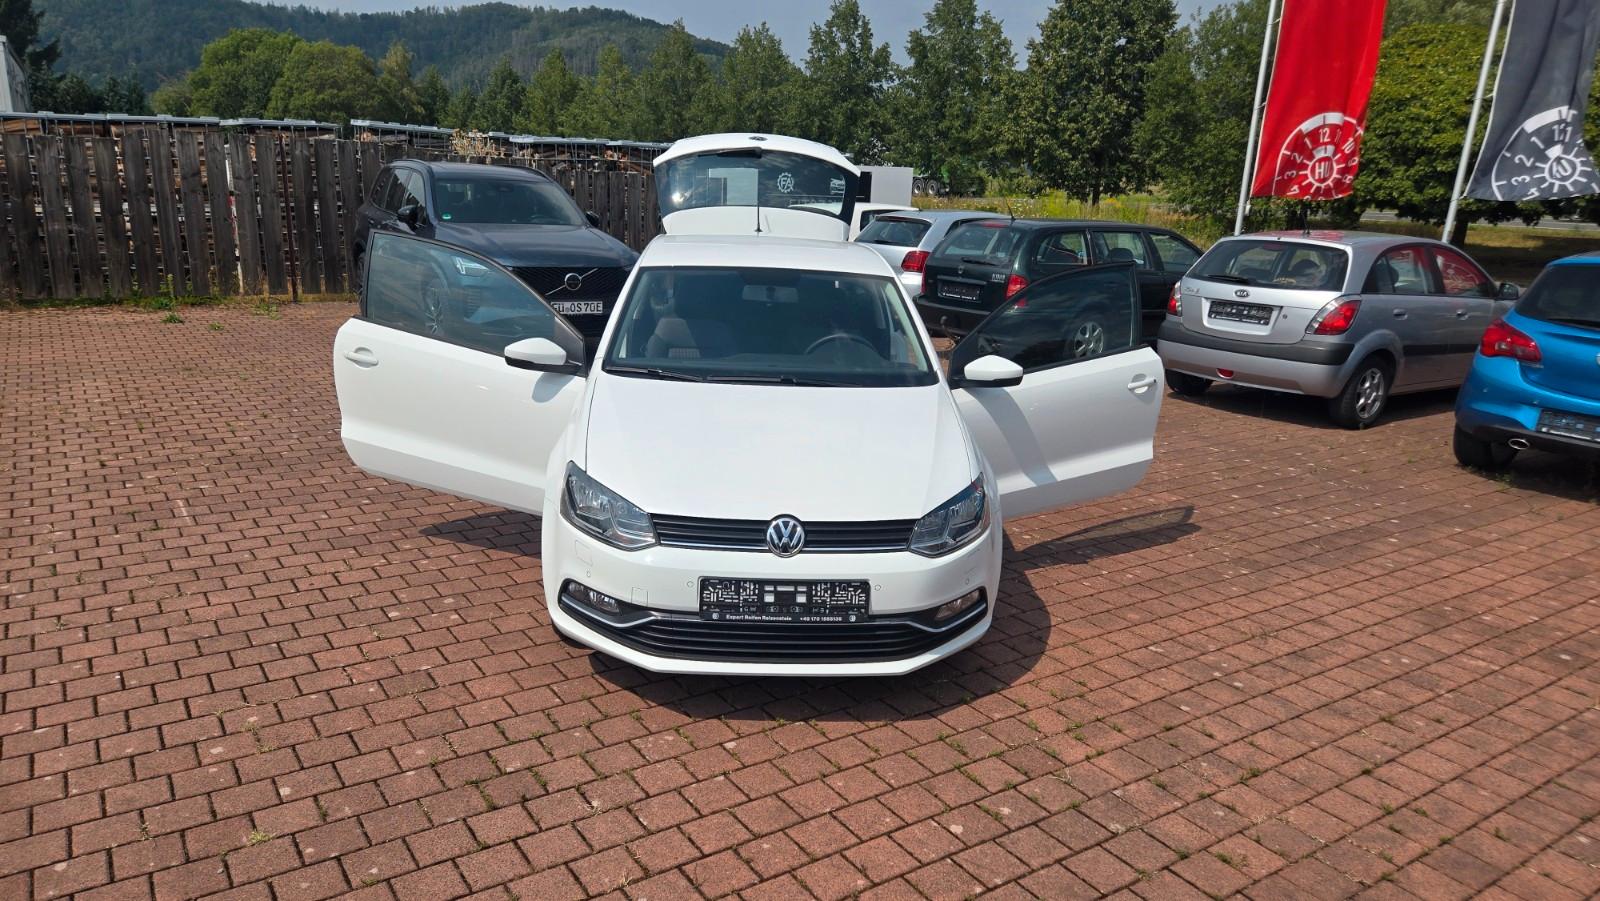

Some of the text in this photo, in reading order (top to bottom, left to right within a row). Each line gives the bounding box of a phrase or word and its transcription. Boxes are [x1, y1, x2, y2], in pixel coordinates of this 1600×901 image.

[1530, 136, 1545, 149] 1
[1284, 170, 1296, 179] 3
[1291, 152, 1303, 163] 2
[1303, 136, 1312, 149] 1
[1318, 127, 1331, 143] 12
[1342, 137, 1355, 154] 10
[1514, 154, 1535, 167] 2
[1511, 175, 1531, 186] 3
